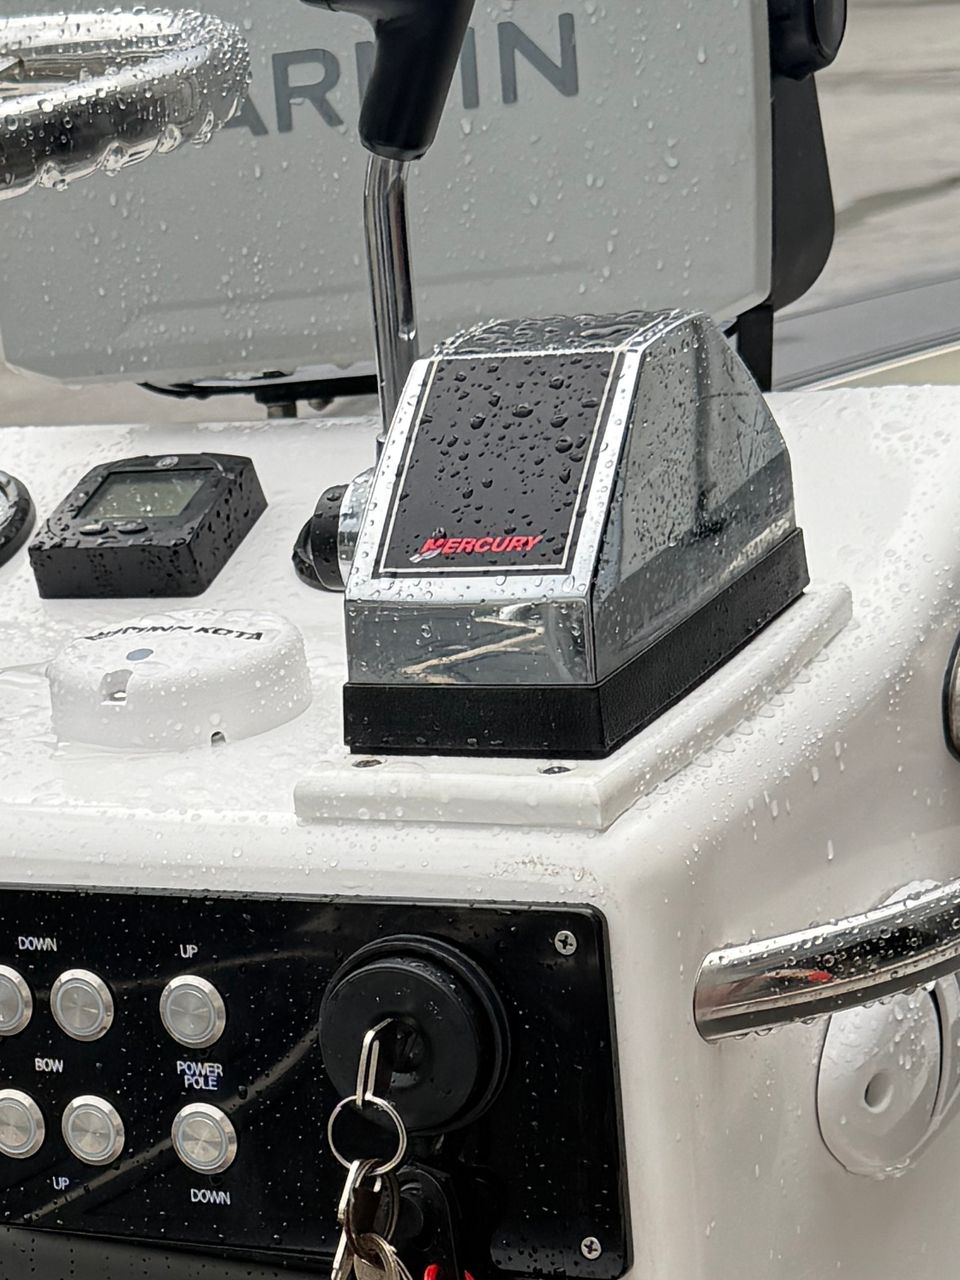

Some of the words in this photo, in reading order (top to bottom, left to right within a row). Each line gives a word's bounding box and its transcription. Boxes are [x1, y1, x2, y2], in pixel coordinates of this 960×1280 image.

[419, 535, 544, 556] MERCURY
[194, 626, 264, 641] KOTA
[18, 937, 58, 952] DOWN
[179, 945, 198, 959] UP
[35, 1058, 63, 1073] BOW
[176, 1061, 223, 1077] POWER
[184, 1075, 218, 1091] POLE
[52, 1177, 70, 1191] UP
[190, 1189, 231, 1205] DOWN
